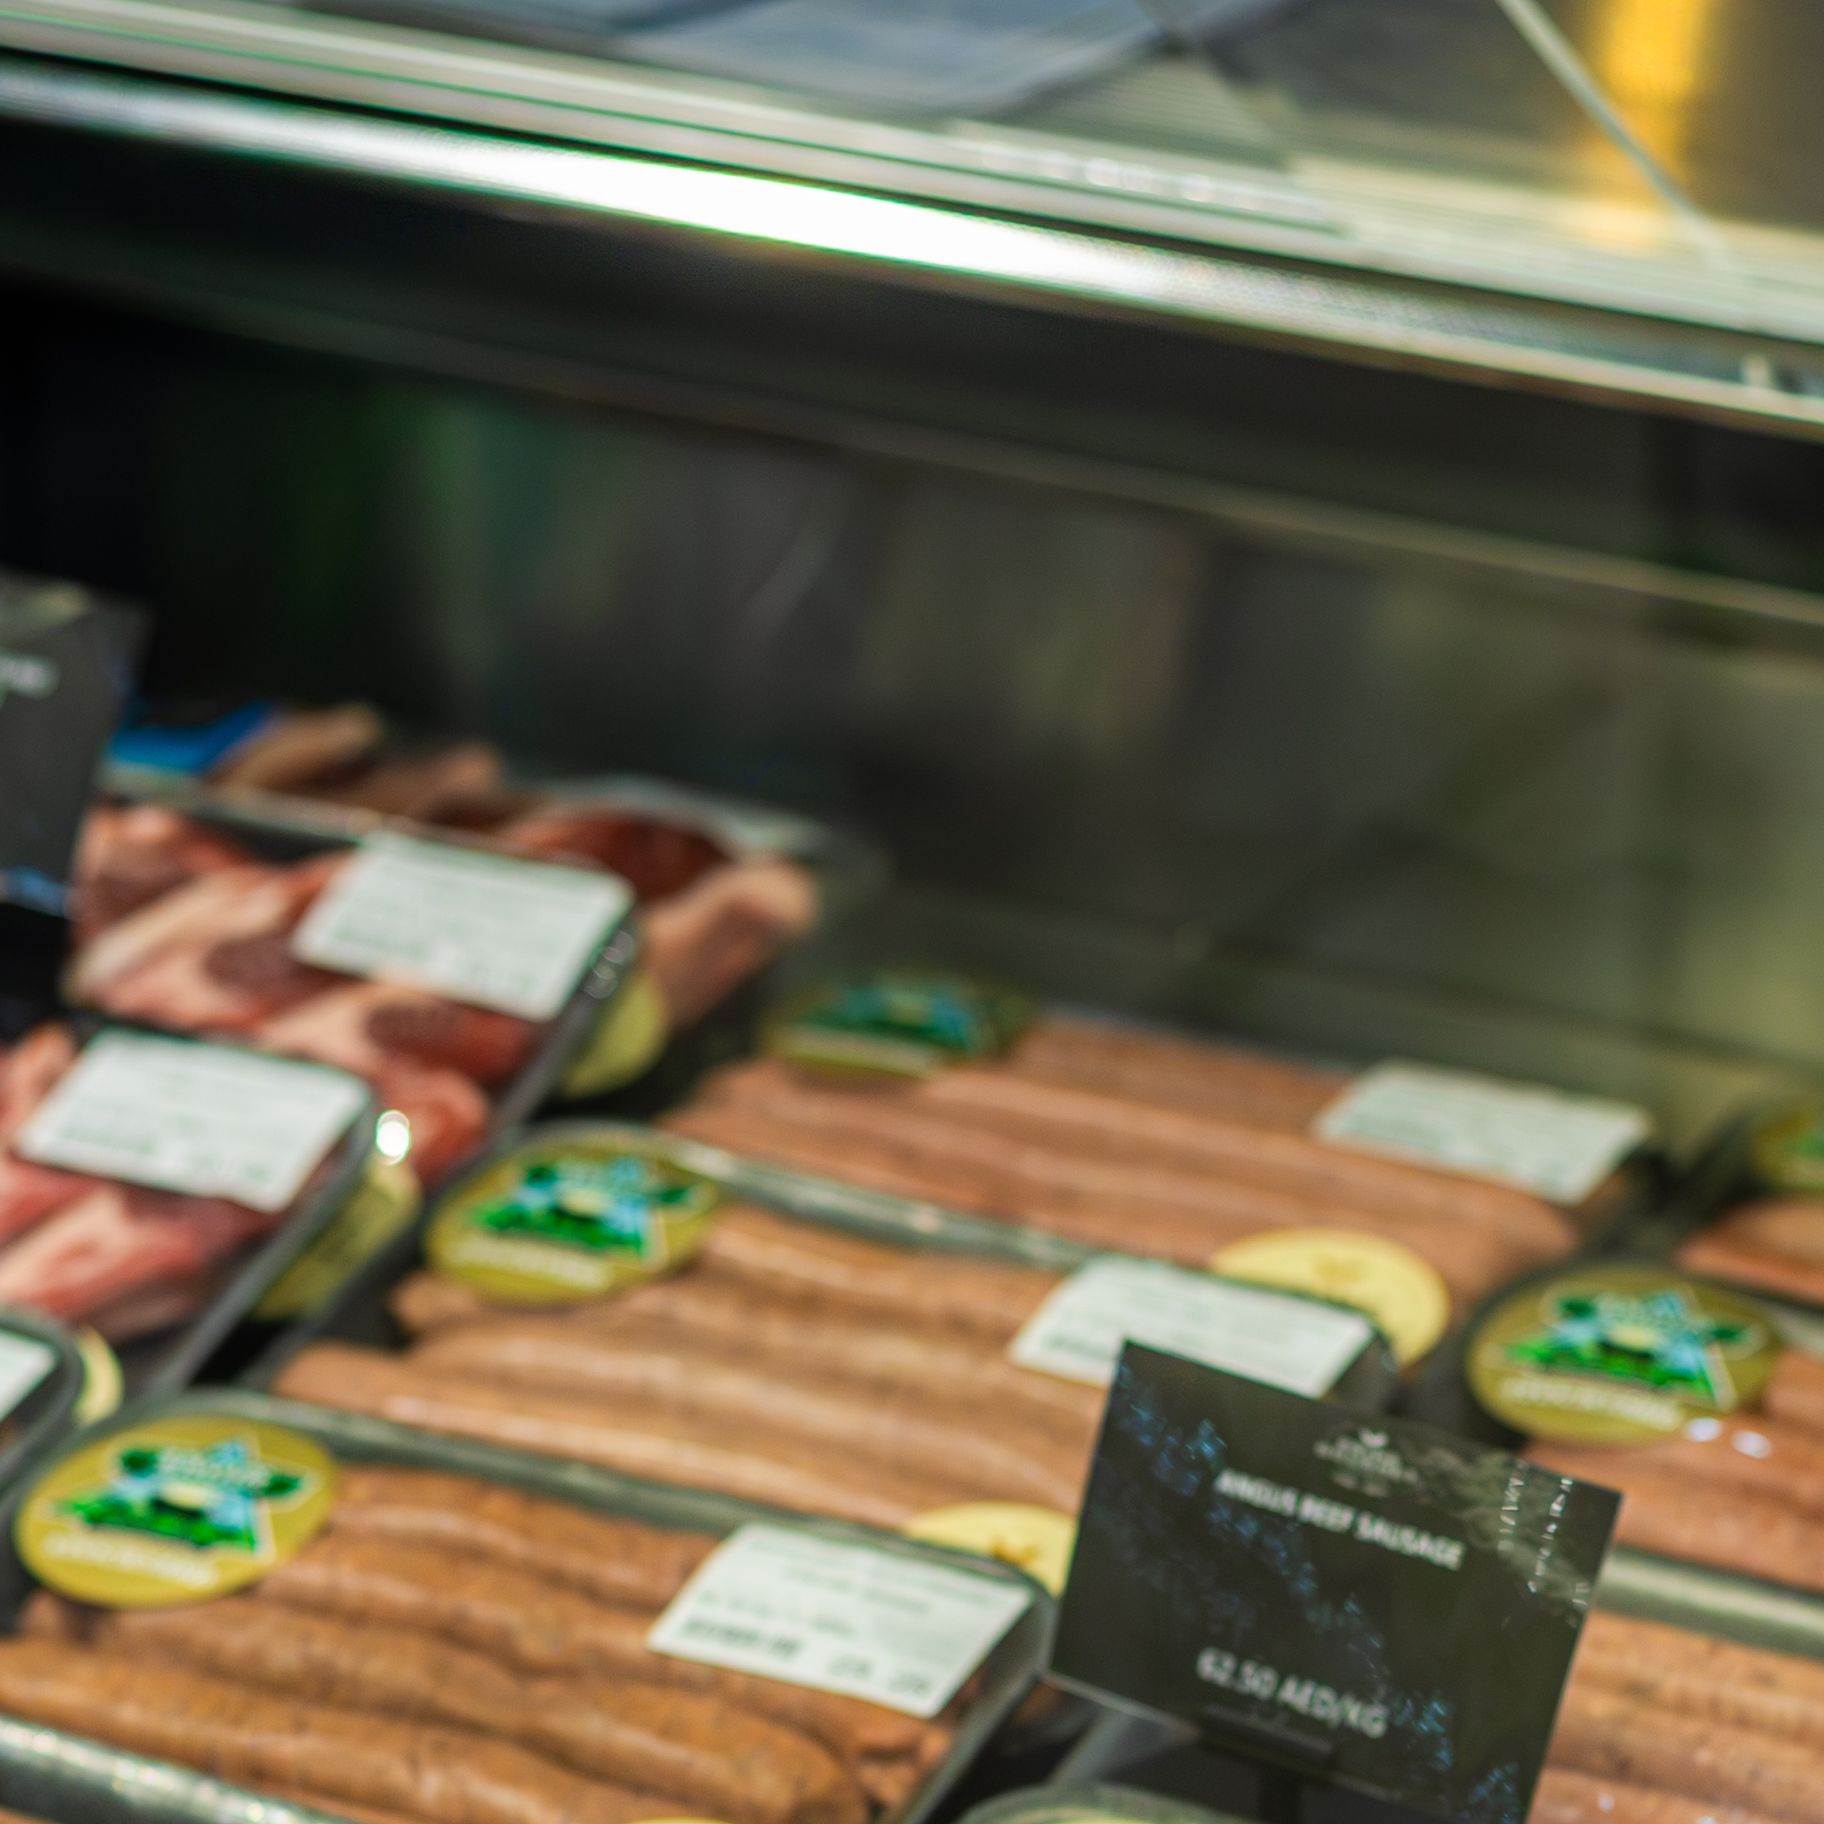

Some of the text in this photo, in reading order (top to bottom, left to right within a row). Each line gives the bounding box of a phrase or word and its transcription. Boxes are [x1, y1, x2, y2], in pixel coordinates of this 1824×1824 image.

[1301, 1492, 1355, 1533] BEEF
[1357, 1512, 1465, 1571] SAUSAGE
[1197, 1649, 1388, 1737] 62.50 AED/KG
